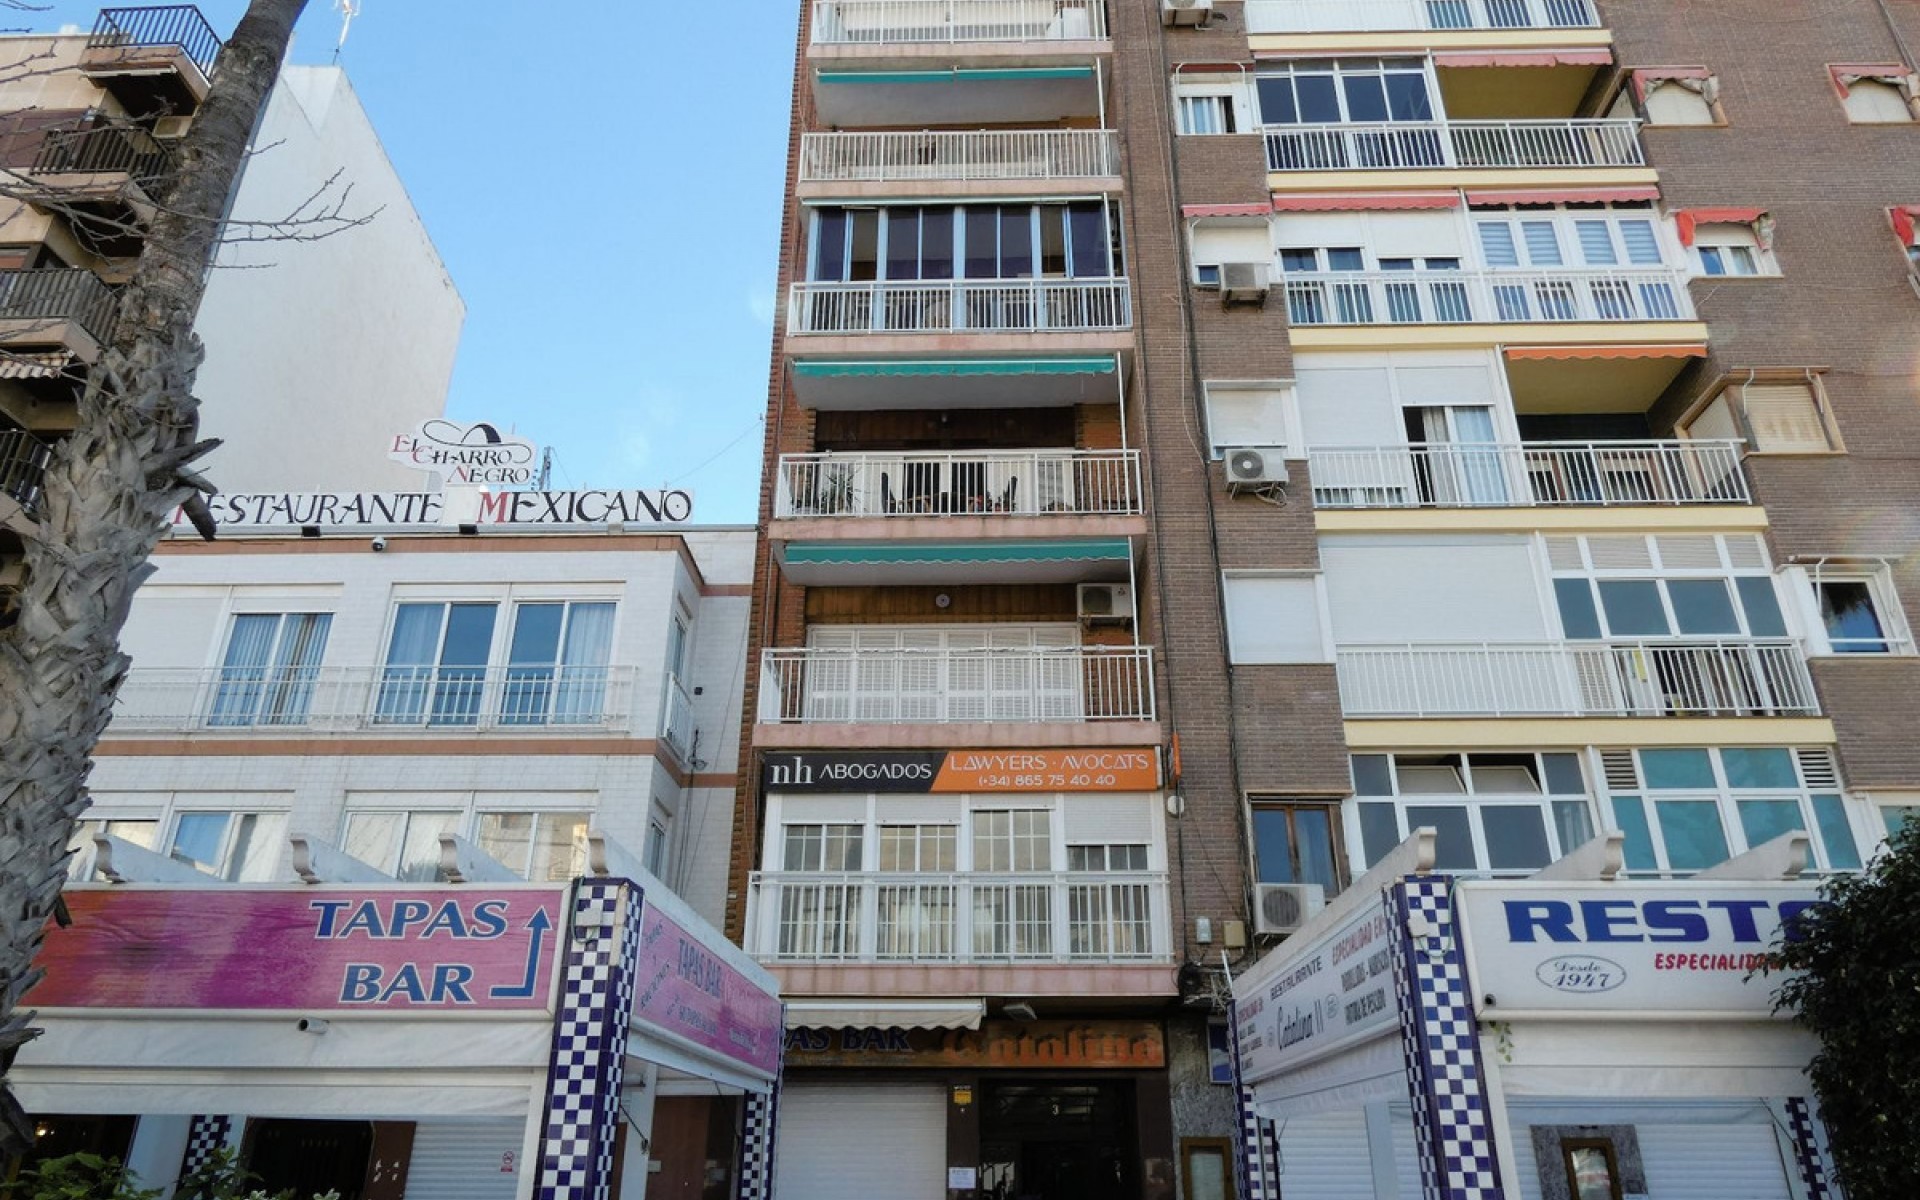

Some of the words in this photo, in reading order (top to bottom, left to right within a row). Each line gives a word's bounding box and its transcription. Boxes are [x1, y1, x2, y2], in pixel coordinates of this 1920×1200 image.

[412, 446, 513, 467] CHARRO
[446, 465, 530, 484] NEGRO
[172, 493, 444, 525] ESTAURANTE
[477, 490, 692, 523] MEXICANO
[770, 756, 815, 784] nh
[819, 763, 933, 780] ABOGADOS
[951, 754, 1048, 771] LAWYERS
[1060, 754, 1150, 771] AVOCATS
[1048, 774, 1065, 786] 75
[1069, 774, 1091, 786] 40
[1095, 774, 1116, 786] 40
[309, 900, 511, 940] TAPAS
[338, 961, 478, 1005] BAR
[1554, 973, 1610, 988] 1947
